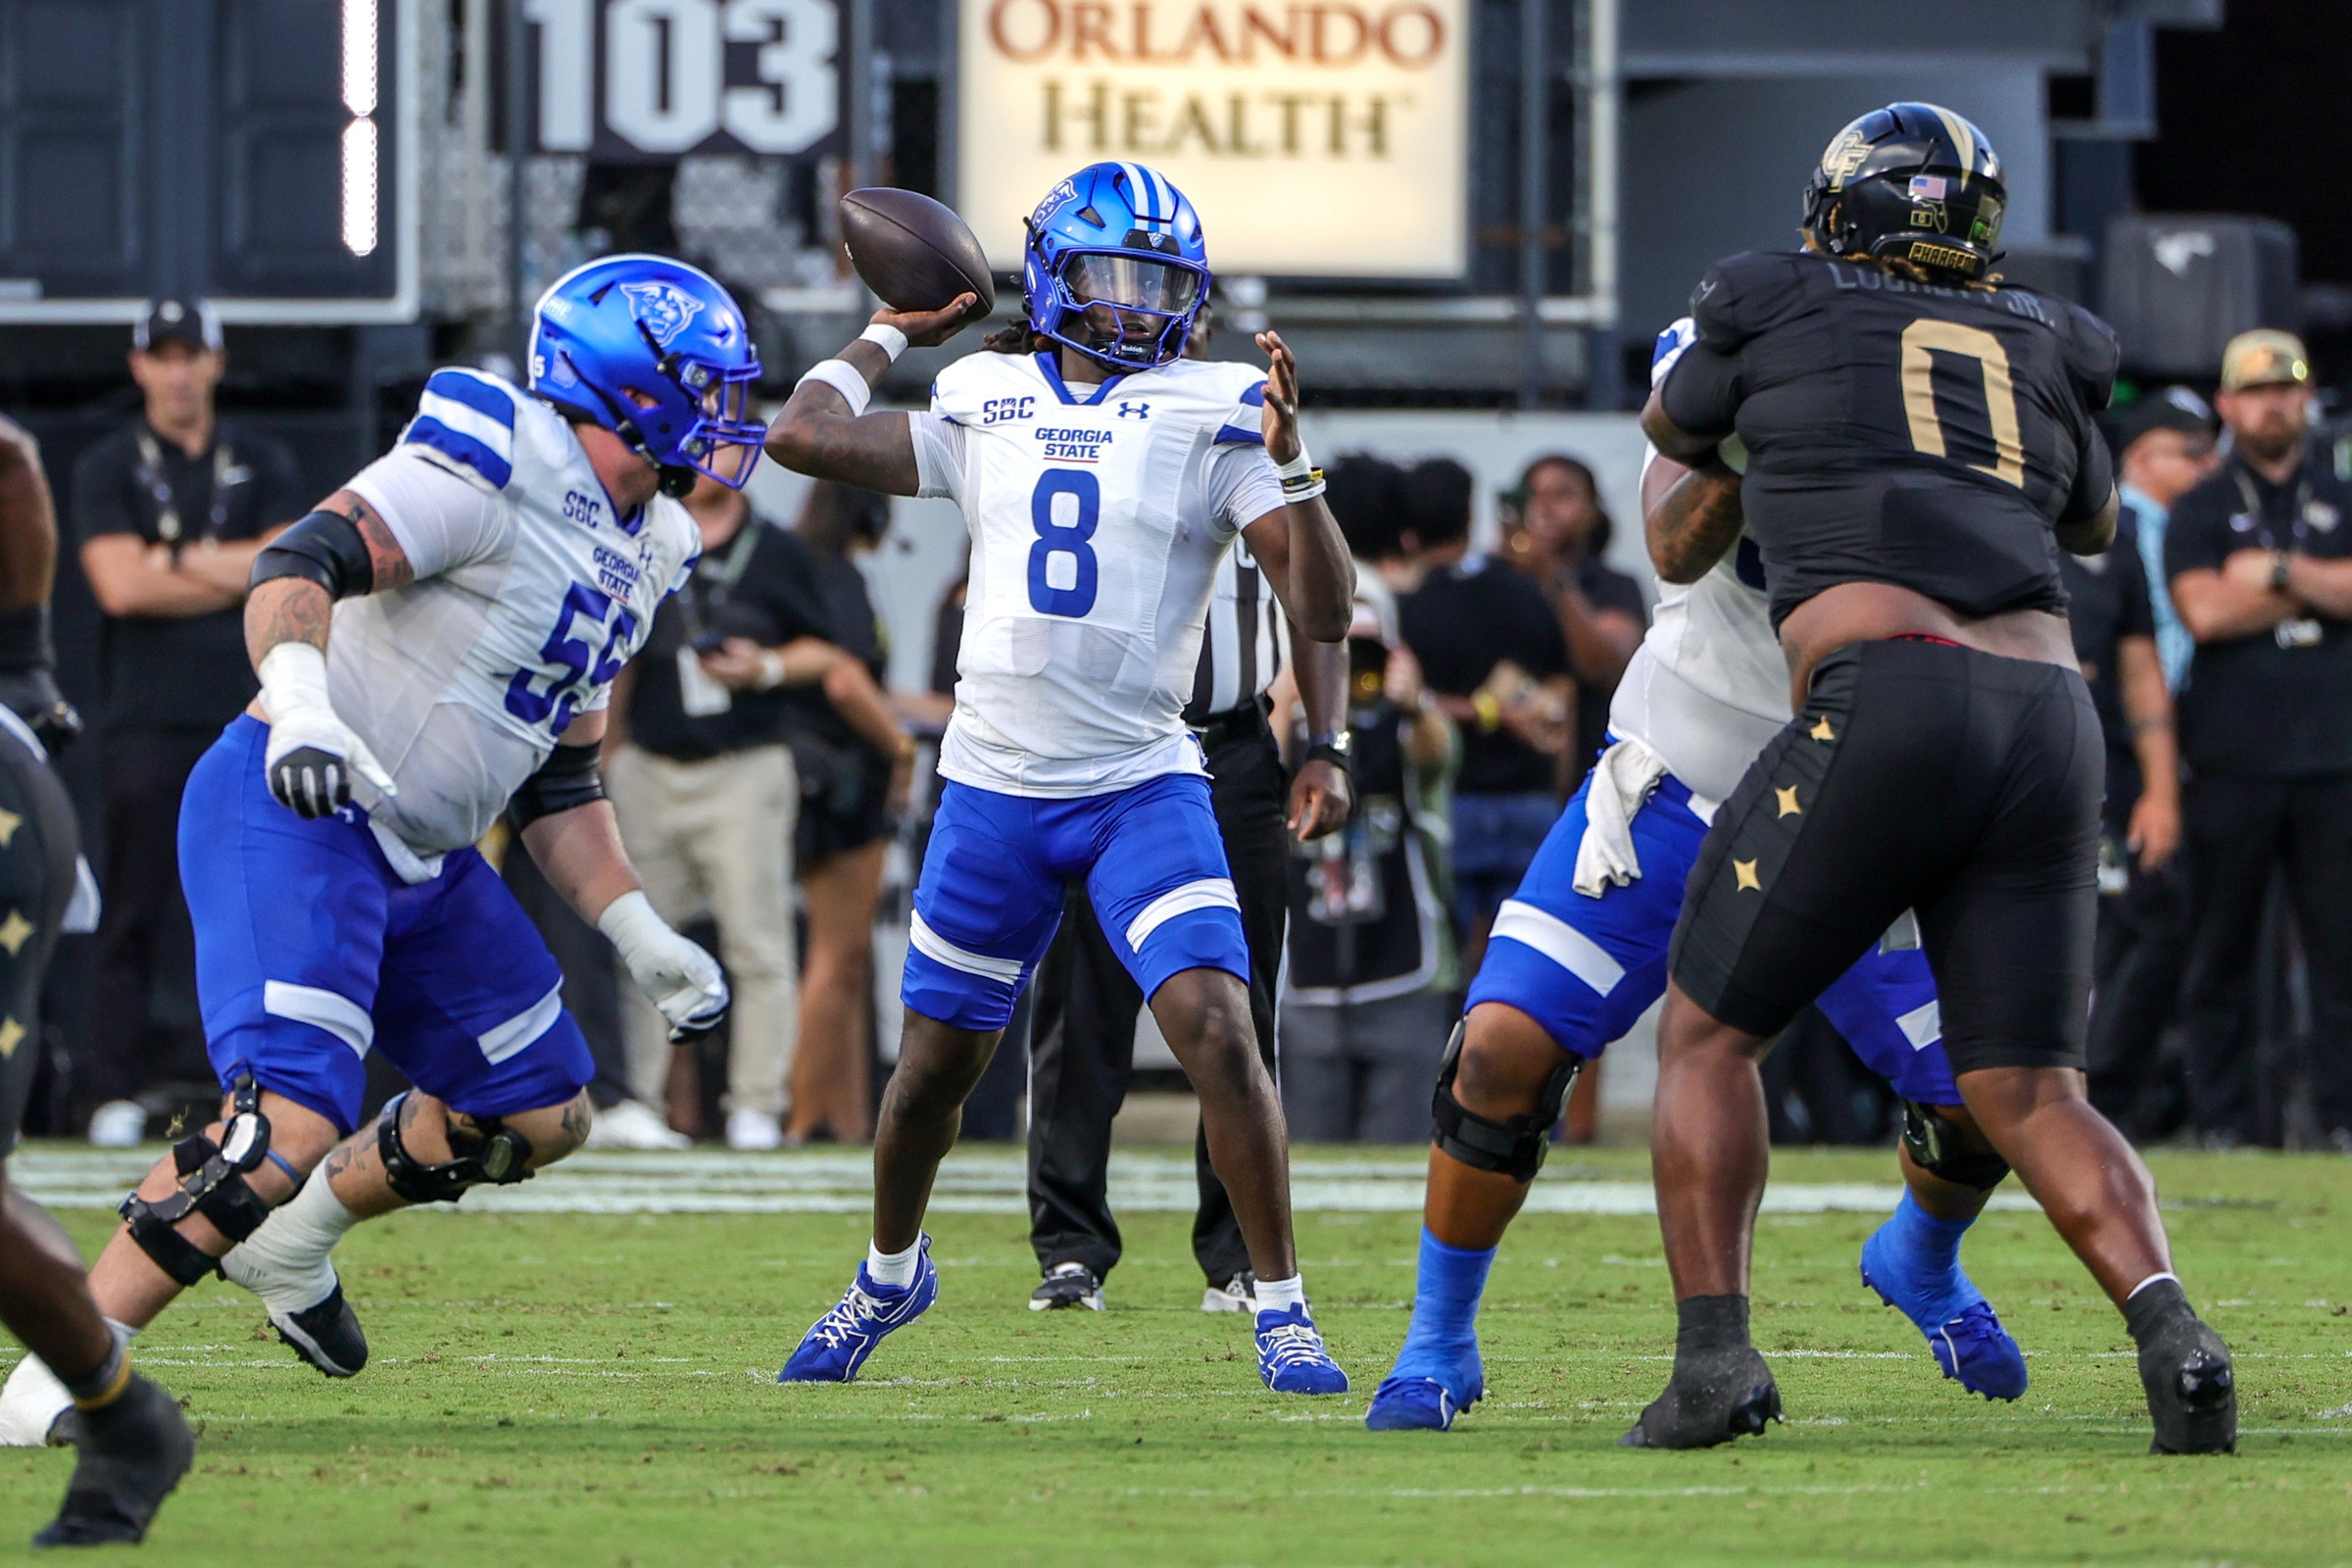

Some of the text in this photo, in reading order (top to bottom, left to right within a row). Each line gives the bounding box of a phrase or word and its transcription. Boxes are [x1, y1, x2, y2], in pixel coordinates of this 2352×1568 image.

[984, 0, 1447, 71] ORLANDO
[522, 0, 840, 154] 103
[1041, 75, 1392, 160] HEALTH
[983, 396, 1036, 424] SBC
[1900, 318, 2026, 490] 0
[1035, 427, 1114, 444] GEORGIA
[1044, 443, 1101, 459] STATE
[563, 490, 601, 529] SBC
[1026, 467, 1101, 618] 8
[598, 568, 634, 599] STATE
